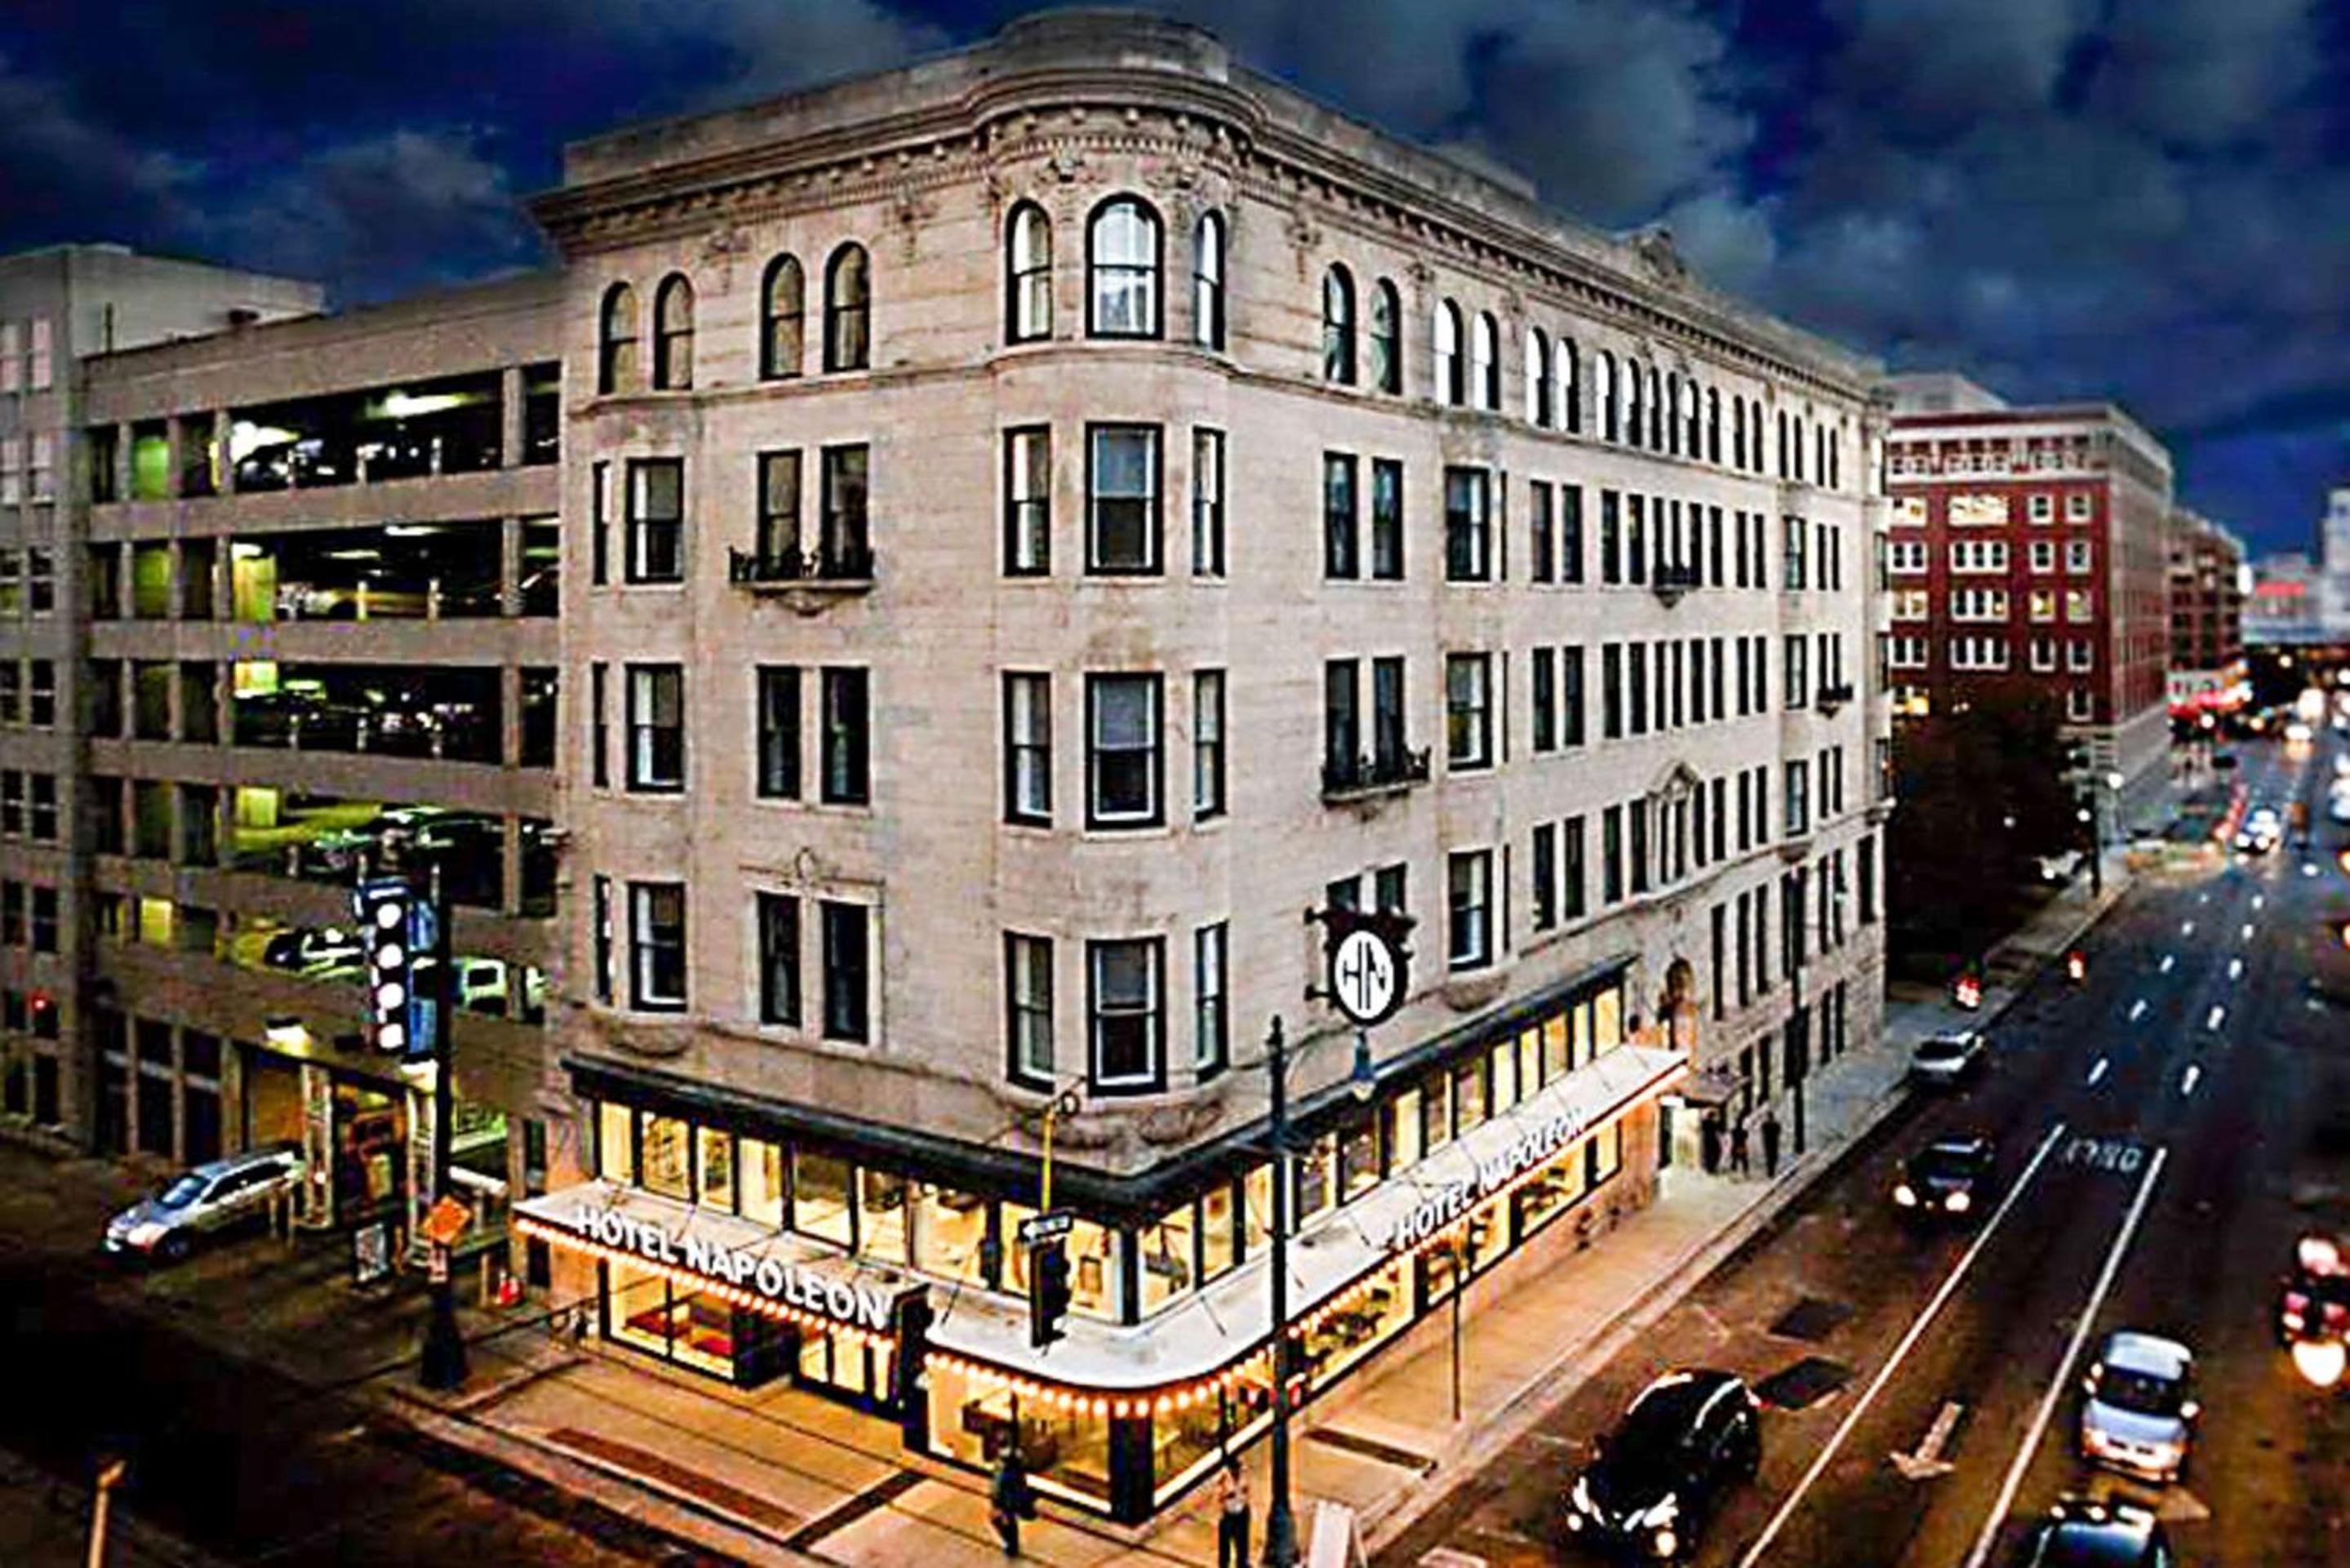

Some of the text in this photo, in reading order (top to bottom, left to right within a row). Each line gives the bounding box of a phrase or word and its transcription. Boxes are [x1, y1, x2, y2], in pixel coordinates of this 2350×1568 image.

[1396, 1185, 1474, 1248] HOTEL
[578, 1205, 893, 1330] HOTEL NAPOLEON
